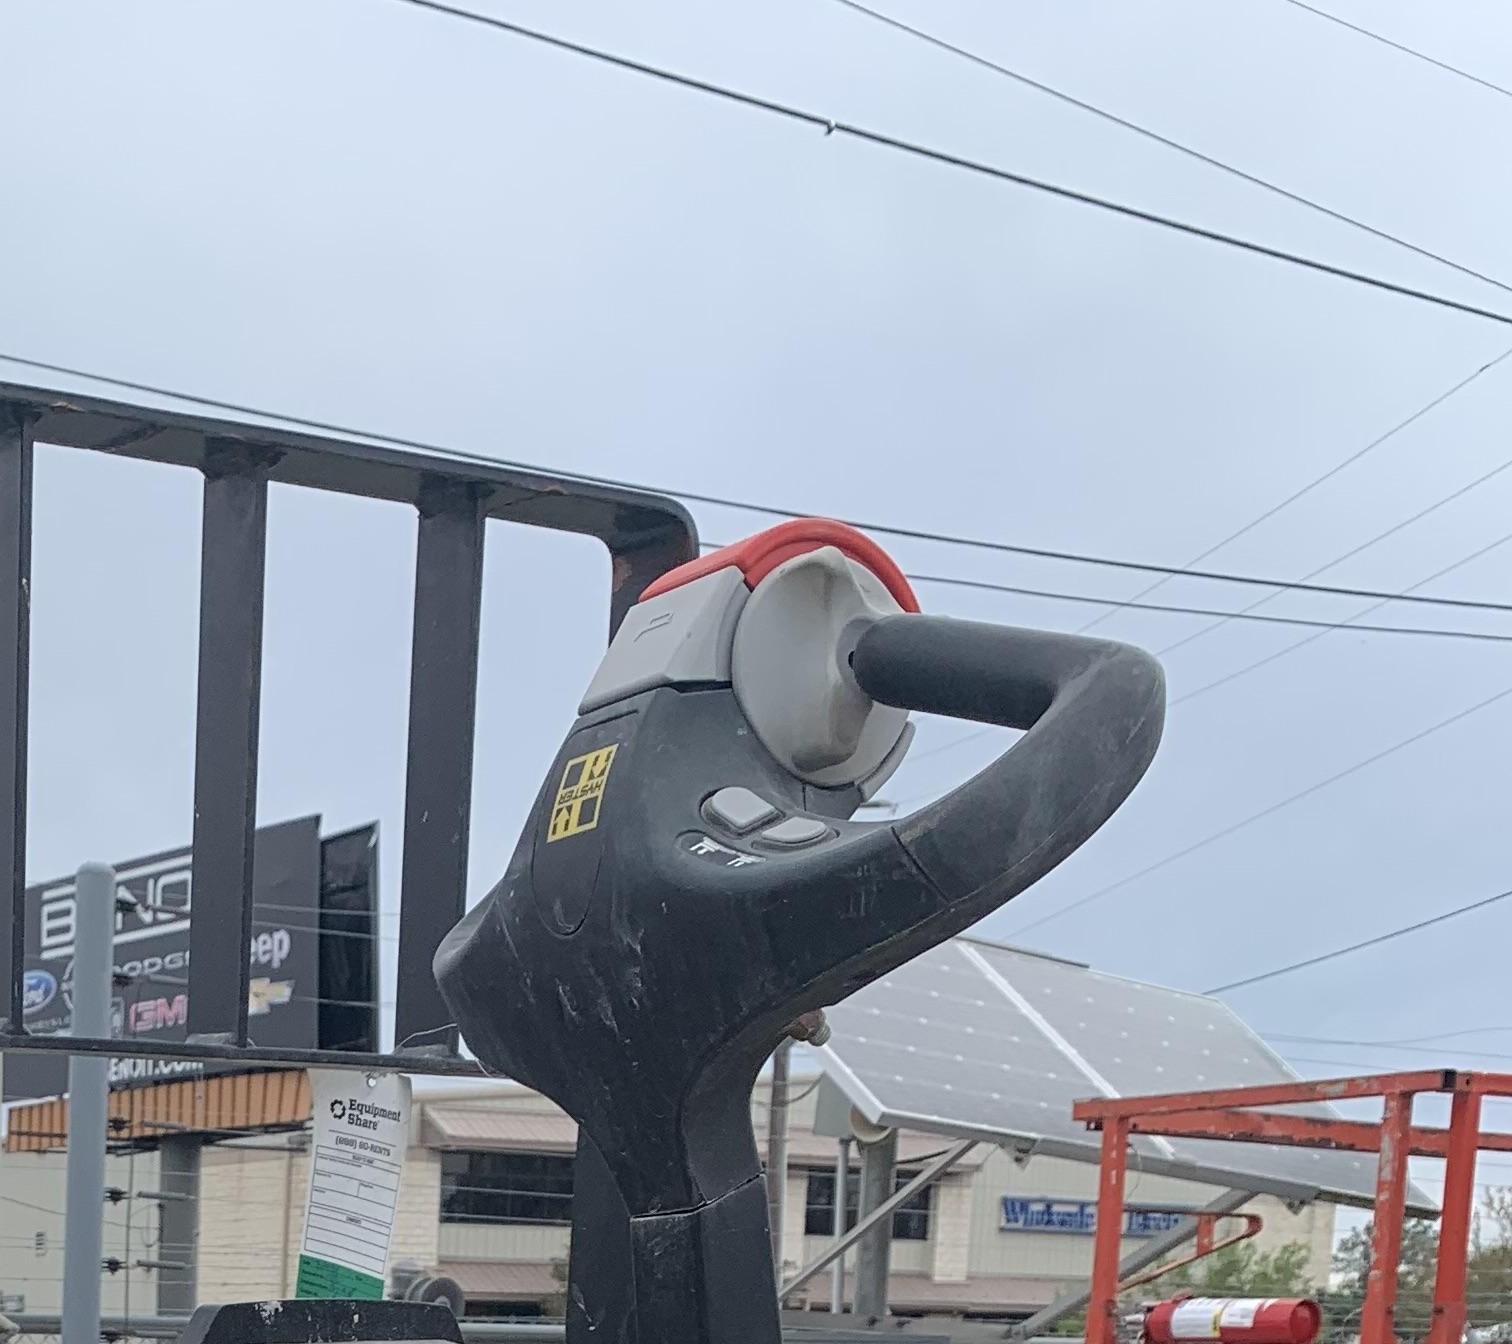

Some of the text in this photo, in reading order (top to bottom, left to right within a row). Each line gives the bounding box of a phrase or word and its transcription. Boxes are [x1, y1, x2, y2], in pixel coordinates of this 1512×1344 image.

[557, 779, 604, 806] HYSTER
[112, 949, 191, 977] ODG
[128, 990, 188, 1032] GM
[346, 1097, 401, 1123] Equipment
[346, 1112, 379, 1131] Share
